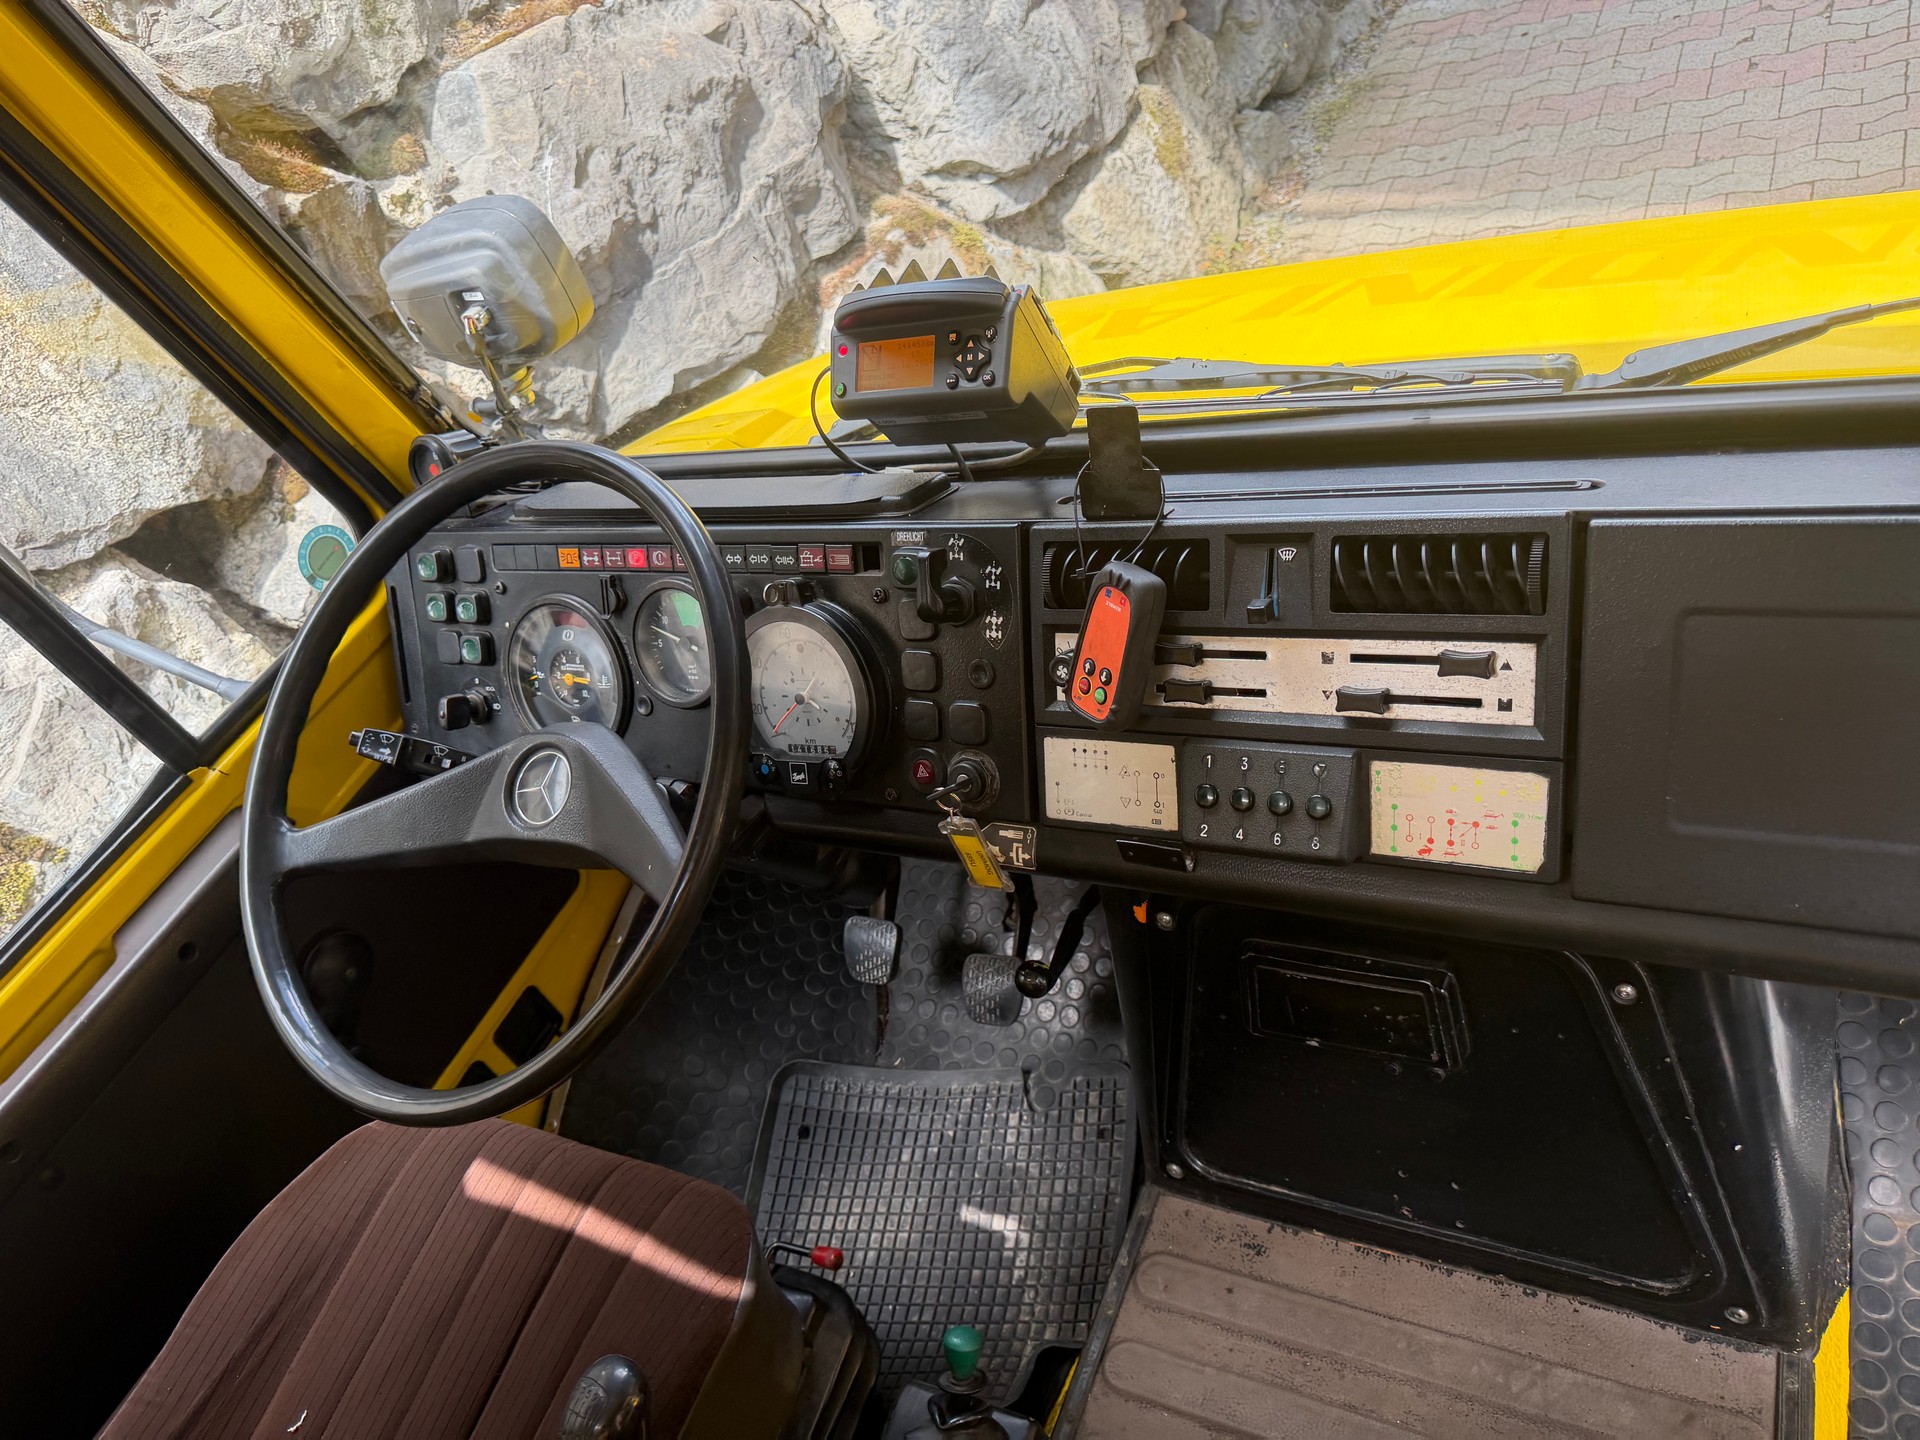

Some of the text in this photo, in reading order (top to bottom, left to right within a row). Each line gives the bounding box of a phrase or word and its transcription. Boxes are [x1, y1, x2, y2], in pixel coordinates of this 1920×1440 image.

[896, 531, 924, 542] DREHLICHT
[780, 627, 791, 639] 60
[658, 639, 663, 647] 5
[752, 703, 763, 715] 20
[805, 737, 817, 745] km
[374, 753, 394, 764] WIPE
[1207, 754, 1212, 768] 1
[1240, 757, 1249, 771] 3
[1200, 824, 1320, 850] 2 4 6 8
